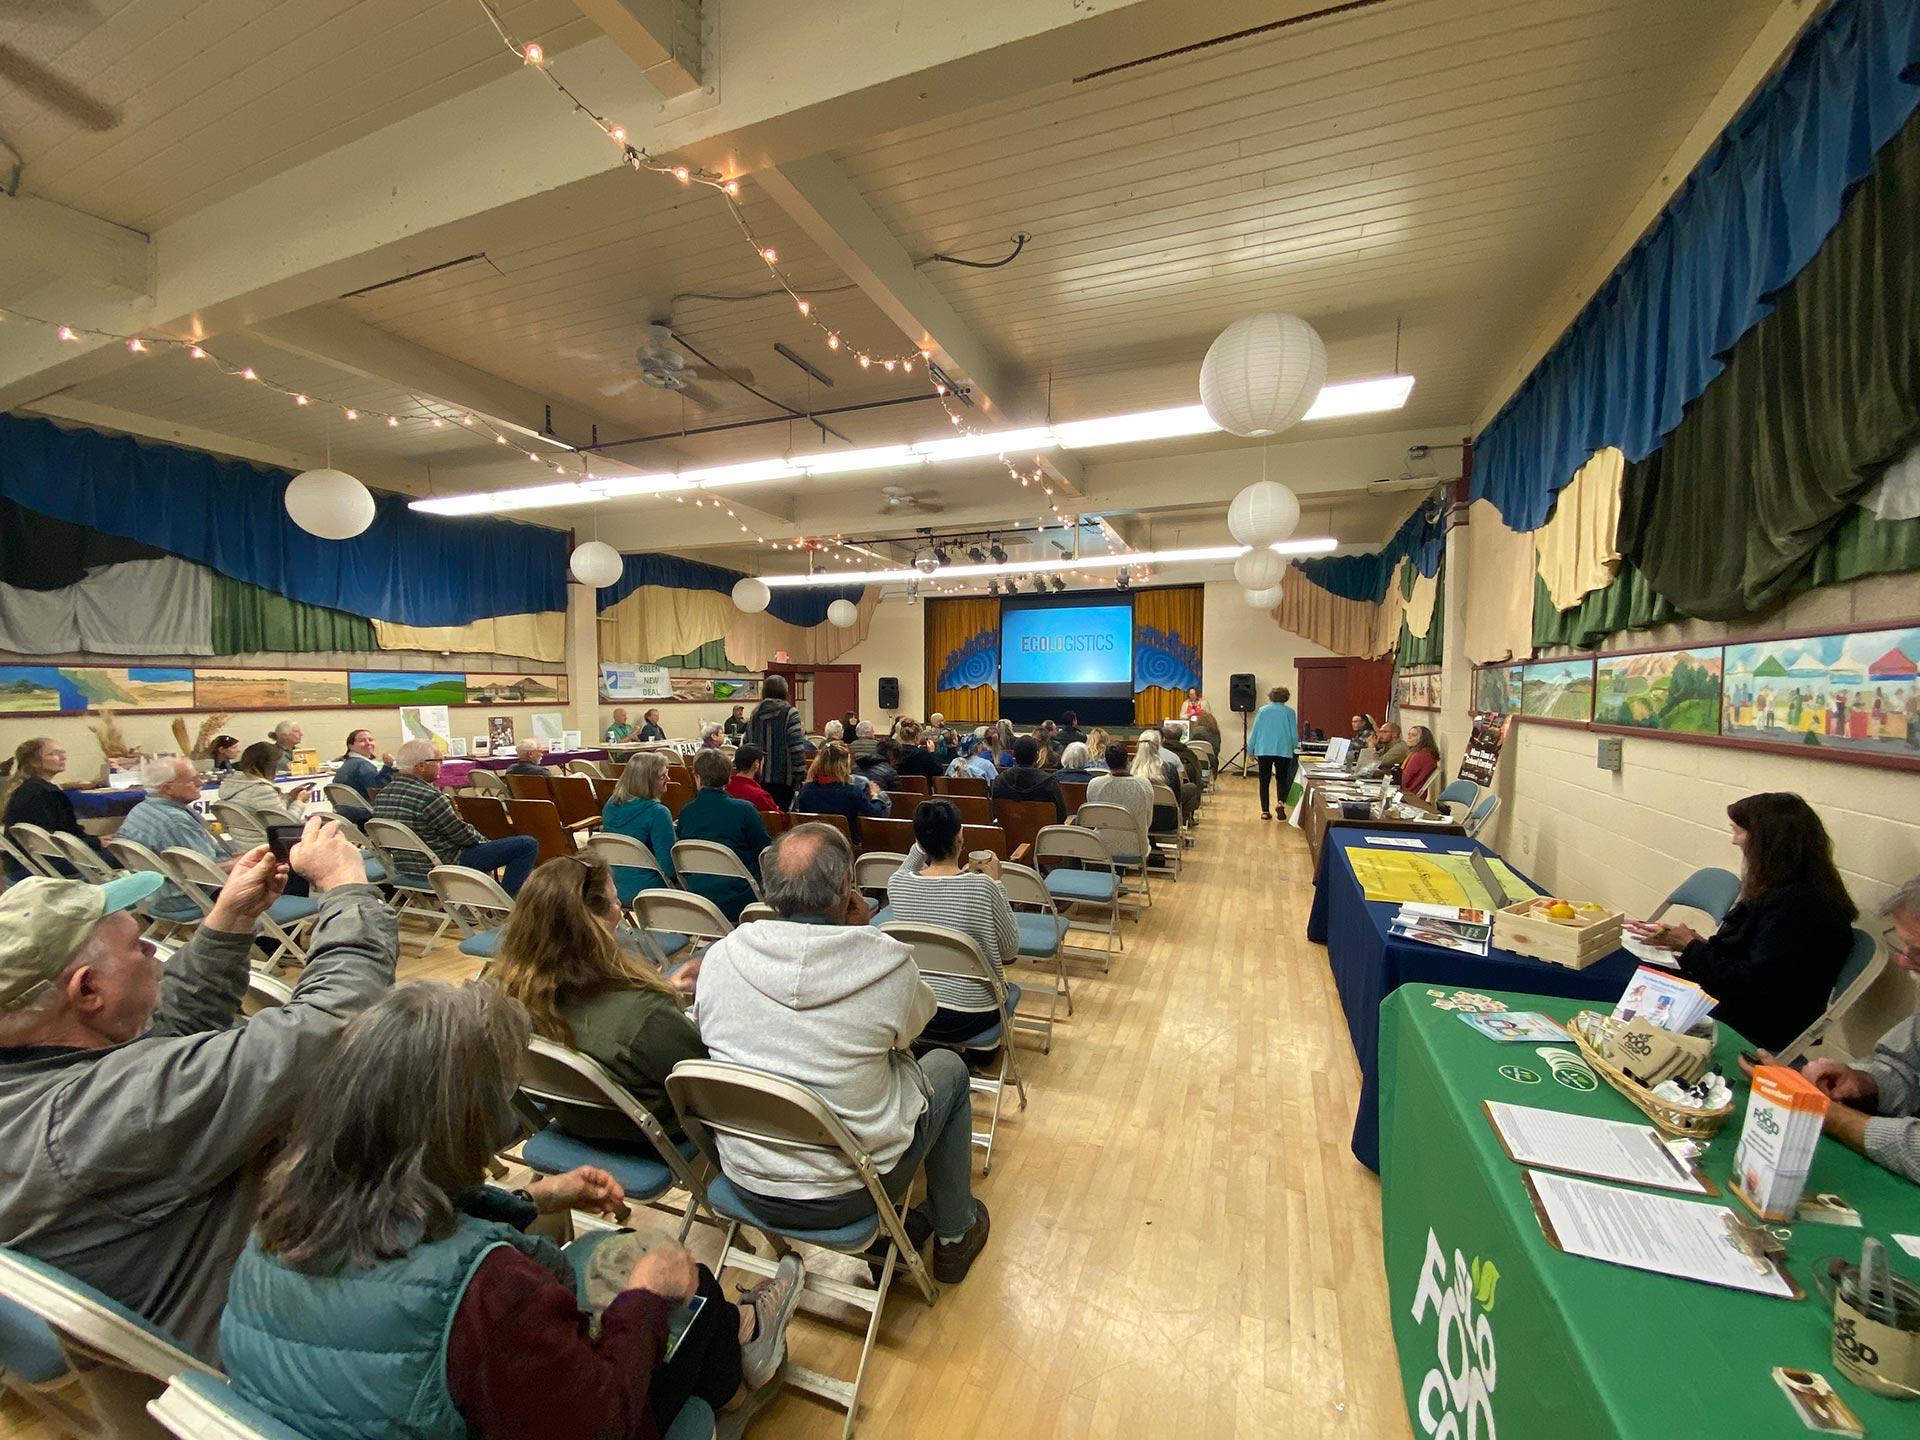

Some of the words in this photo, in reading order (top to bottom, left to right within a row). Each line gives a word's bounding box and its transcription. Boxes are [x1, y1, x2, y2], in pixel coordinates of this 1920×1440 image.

[1021, 634, 1114, 652] ECOLOGISTICS
[639, 665, 660, 673] GREEN
[681, 743, 696, 755] BAN
[1623, 1032, 1651, 1056] FOOD
[1753, 1107, 1779, 1136] FOOD
[1454, 1248, 1496, 1393] SLO
[1411, 1226, 1497, 1440] FOO
